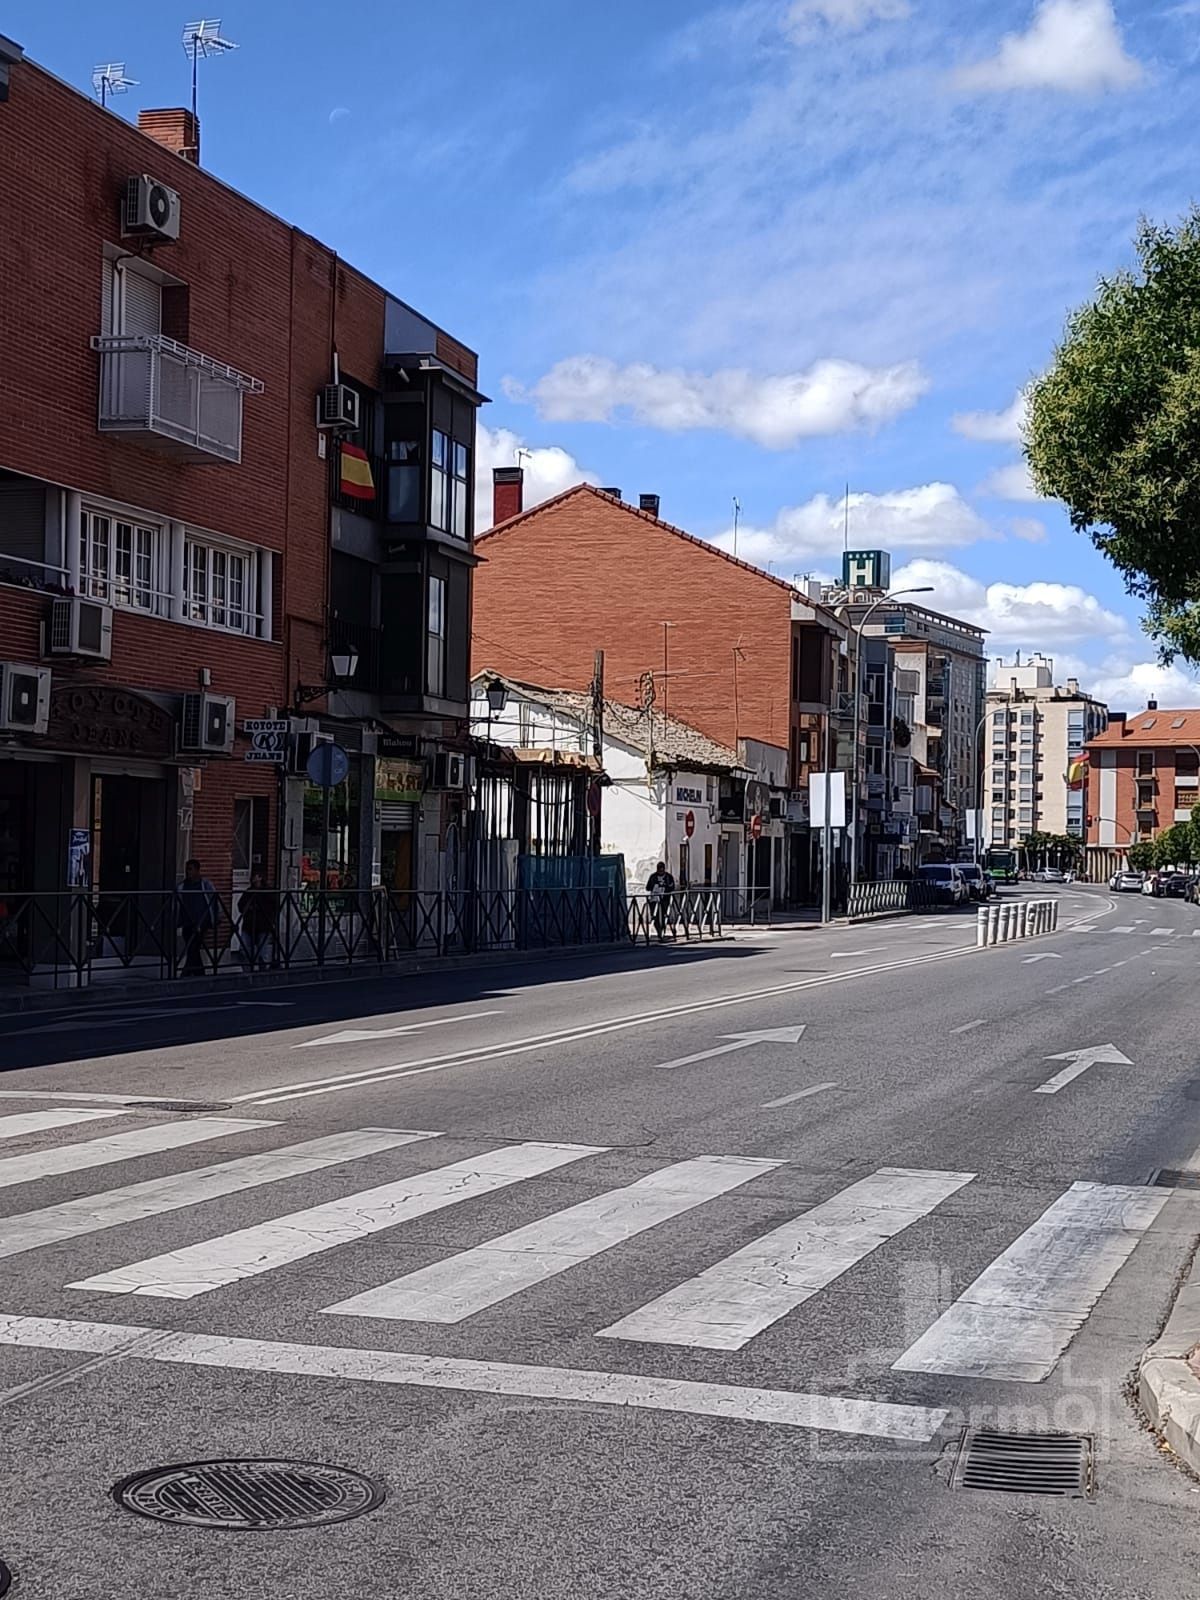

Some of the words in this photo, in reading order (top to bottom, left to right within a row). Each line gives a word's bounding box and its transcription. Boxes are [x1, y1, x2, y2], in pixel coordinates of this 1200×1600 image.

[246, 721, 286, 730] KOYOTE
[71, 723, 144, 749] JEANS
[246, 752, 282, 760] JEANS
